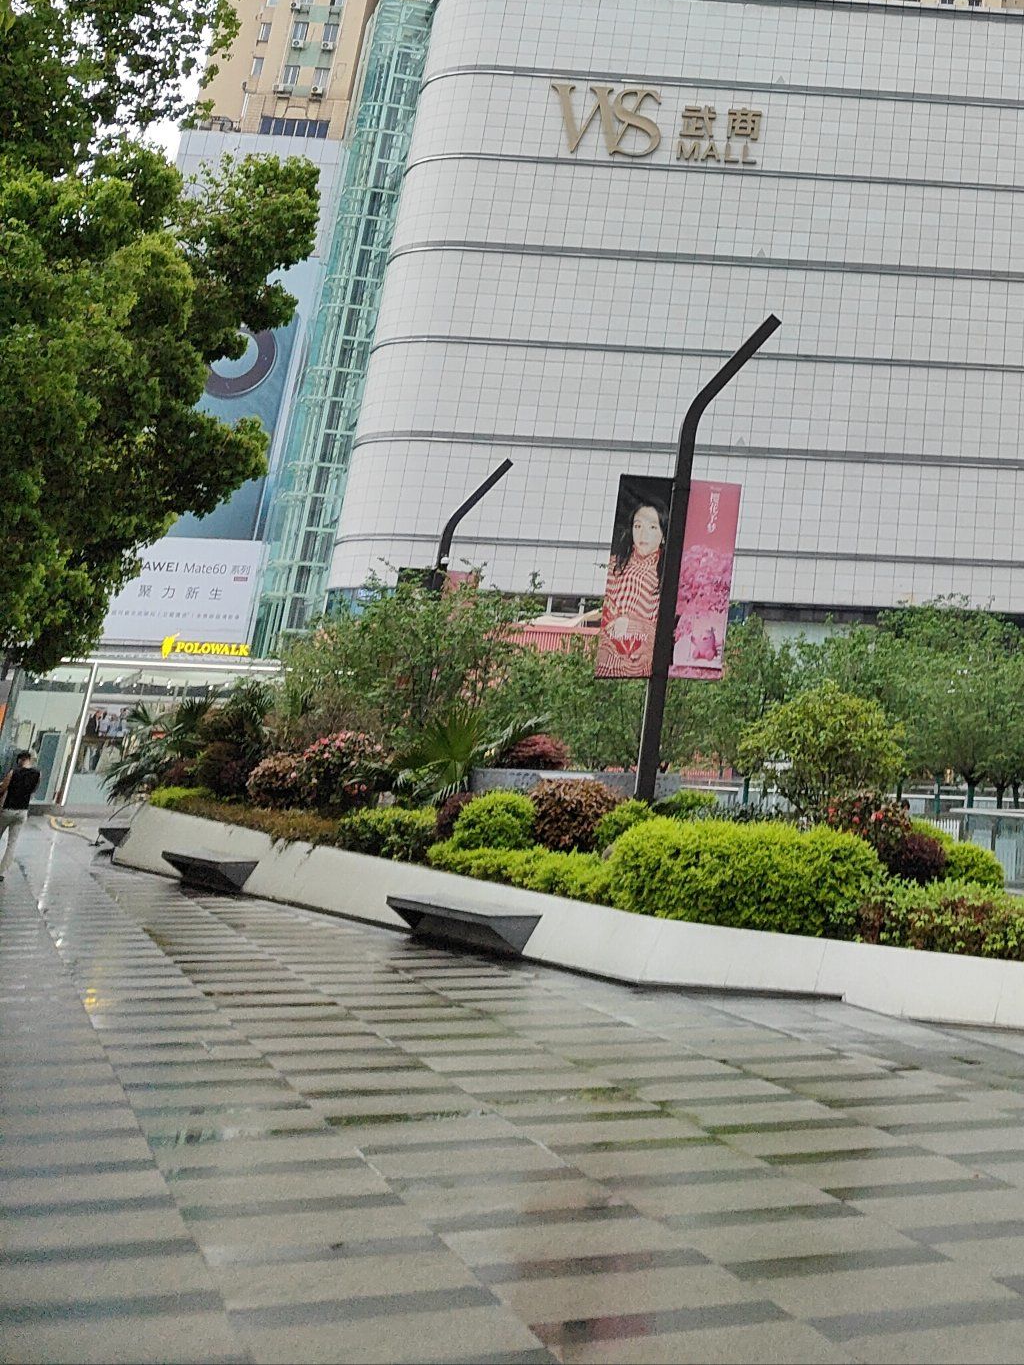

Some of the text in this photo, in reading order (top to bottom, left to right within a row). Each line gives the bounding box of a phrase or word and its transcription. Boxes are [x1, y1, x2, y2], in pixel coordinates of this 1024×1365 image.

[679, 105, 763, 141] 武商
[676, 140, 757, 165] MALL
[141, 561, 179, 573] AWEI
[183, 562, 227, 575] Mate60
[137, 584, 223, 601] 聚力新生
[174, 640, 249, 657] POLOWALK
